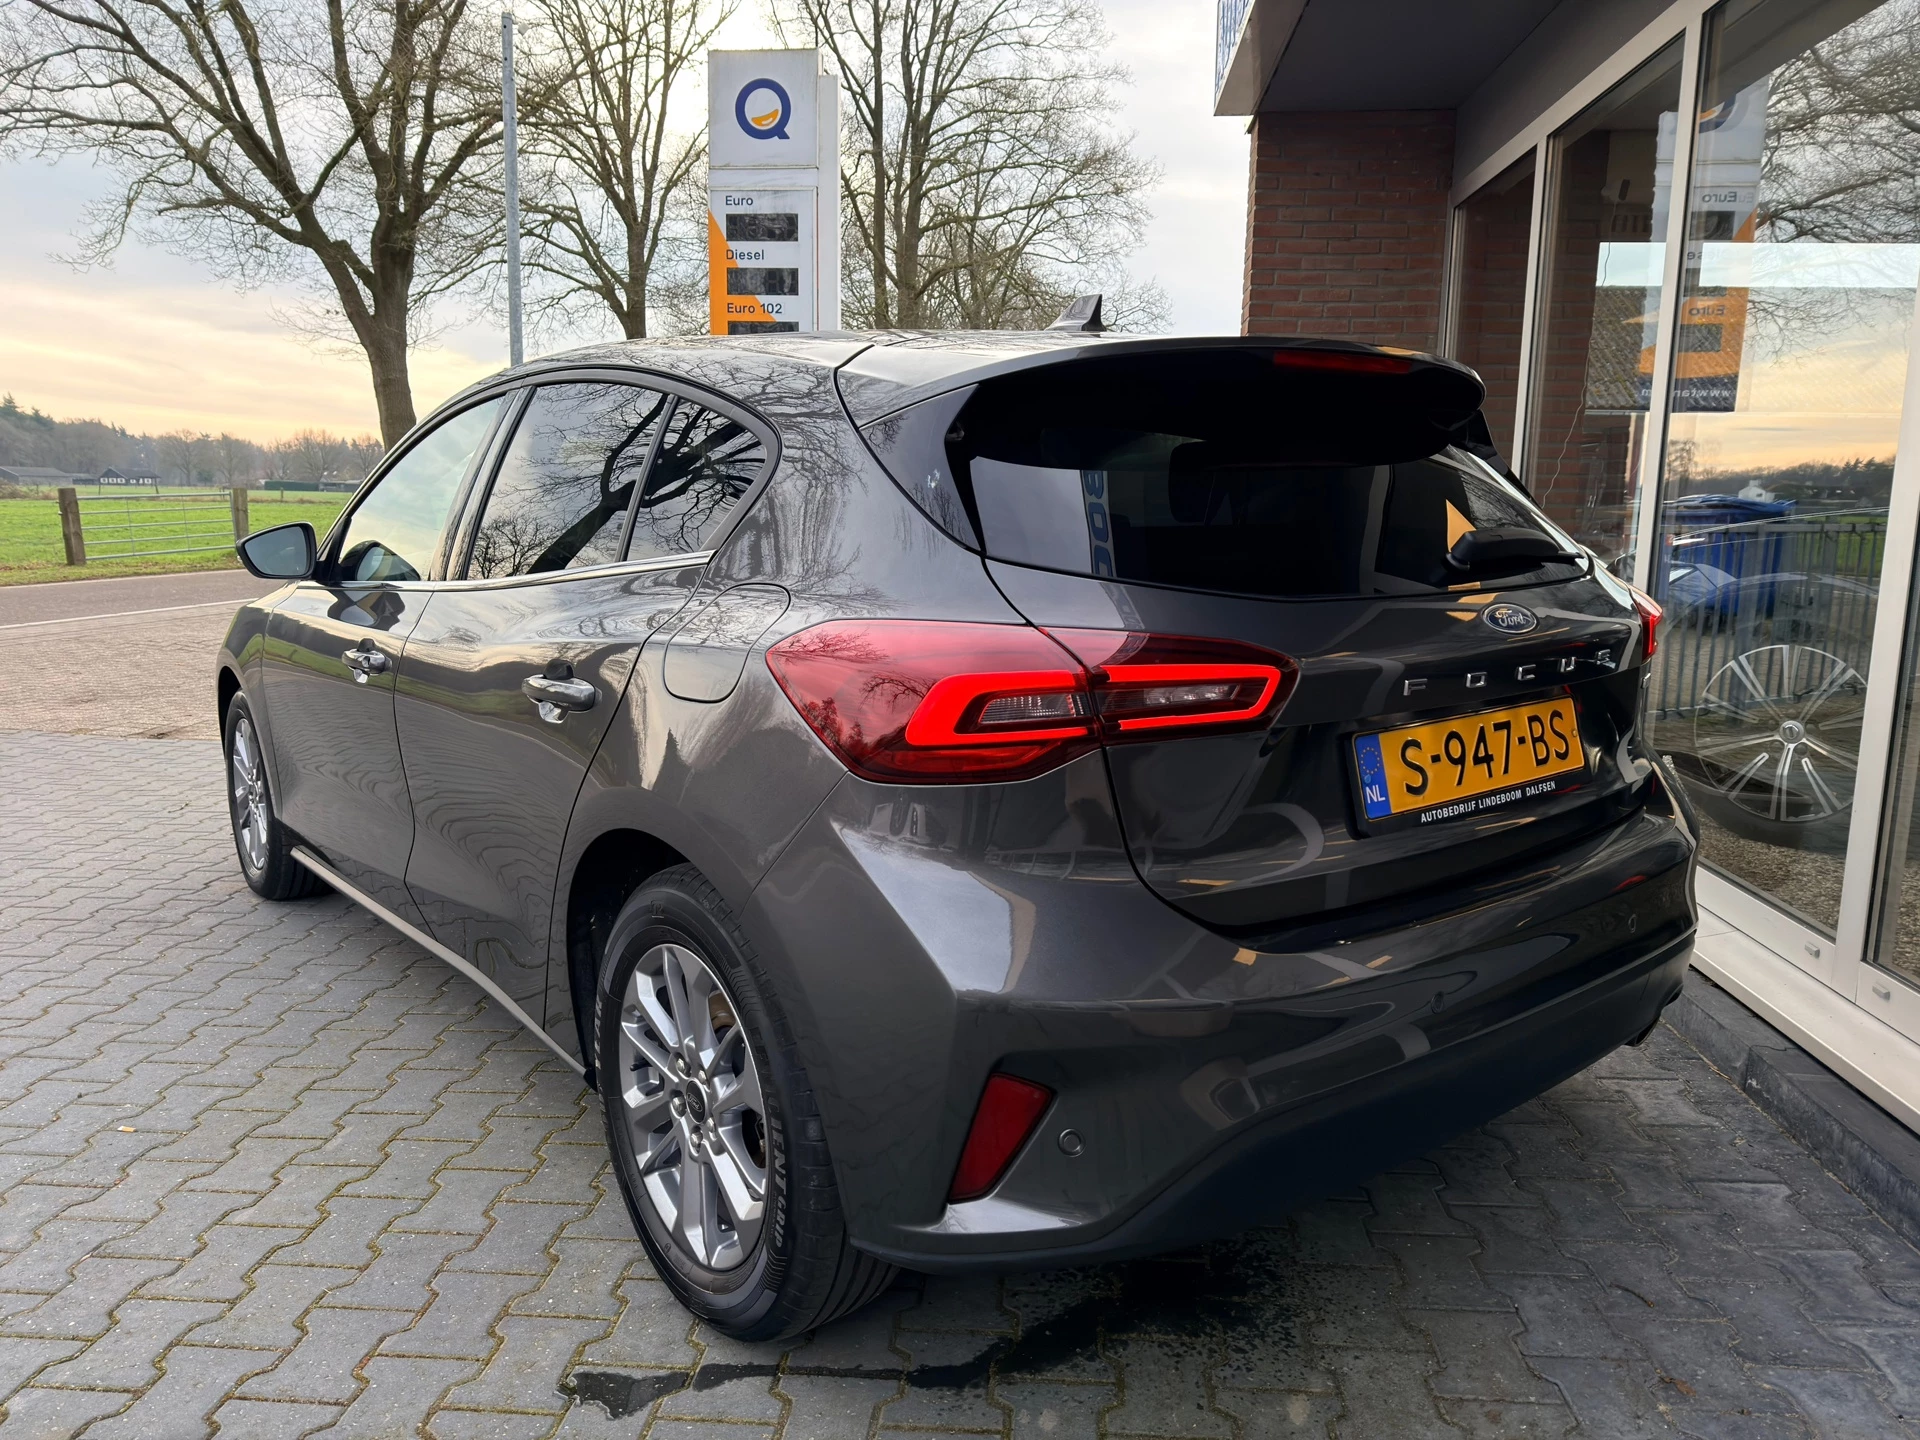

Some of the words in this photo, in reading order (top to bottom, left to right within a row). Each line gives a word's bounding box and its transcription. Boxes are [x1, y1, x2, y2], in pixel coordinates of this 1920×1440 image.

[725, 195, 754, 206] Euro
[726, 250, 765, 261] Diesel
[727, 303, 756, 314] Euro
[760, 303, 783, 314] 102
[1403, 649, 1617, 696] FOCUS
[1400, 709, 1570, 796] S-947-BS
[1366, 785, 1386, 804] NL
[1421, 801, 1477, 824] AUTOBEDRIJF
[1479, 788, 1523, 809] LINDEBOOM
[1526, 780, 1557, 796] DALFSEN
[774, 1195, 787, 1249] GRIP
